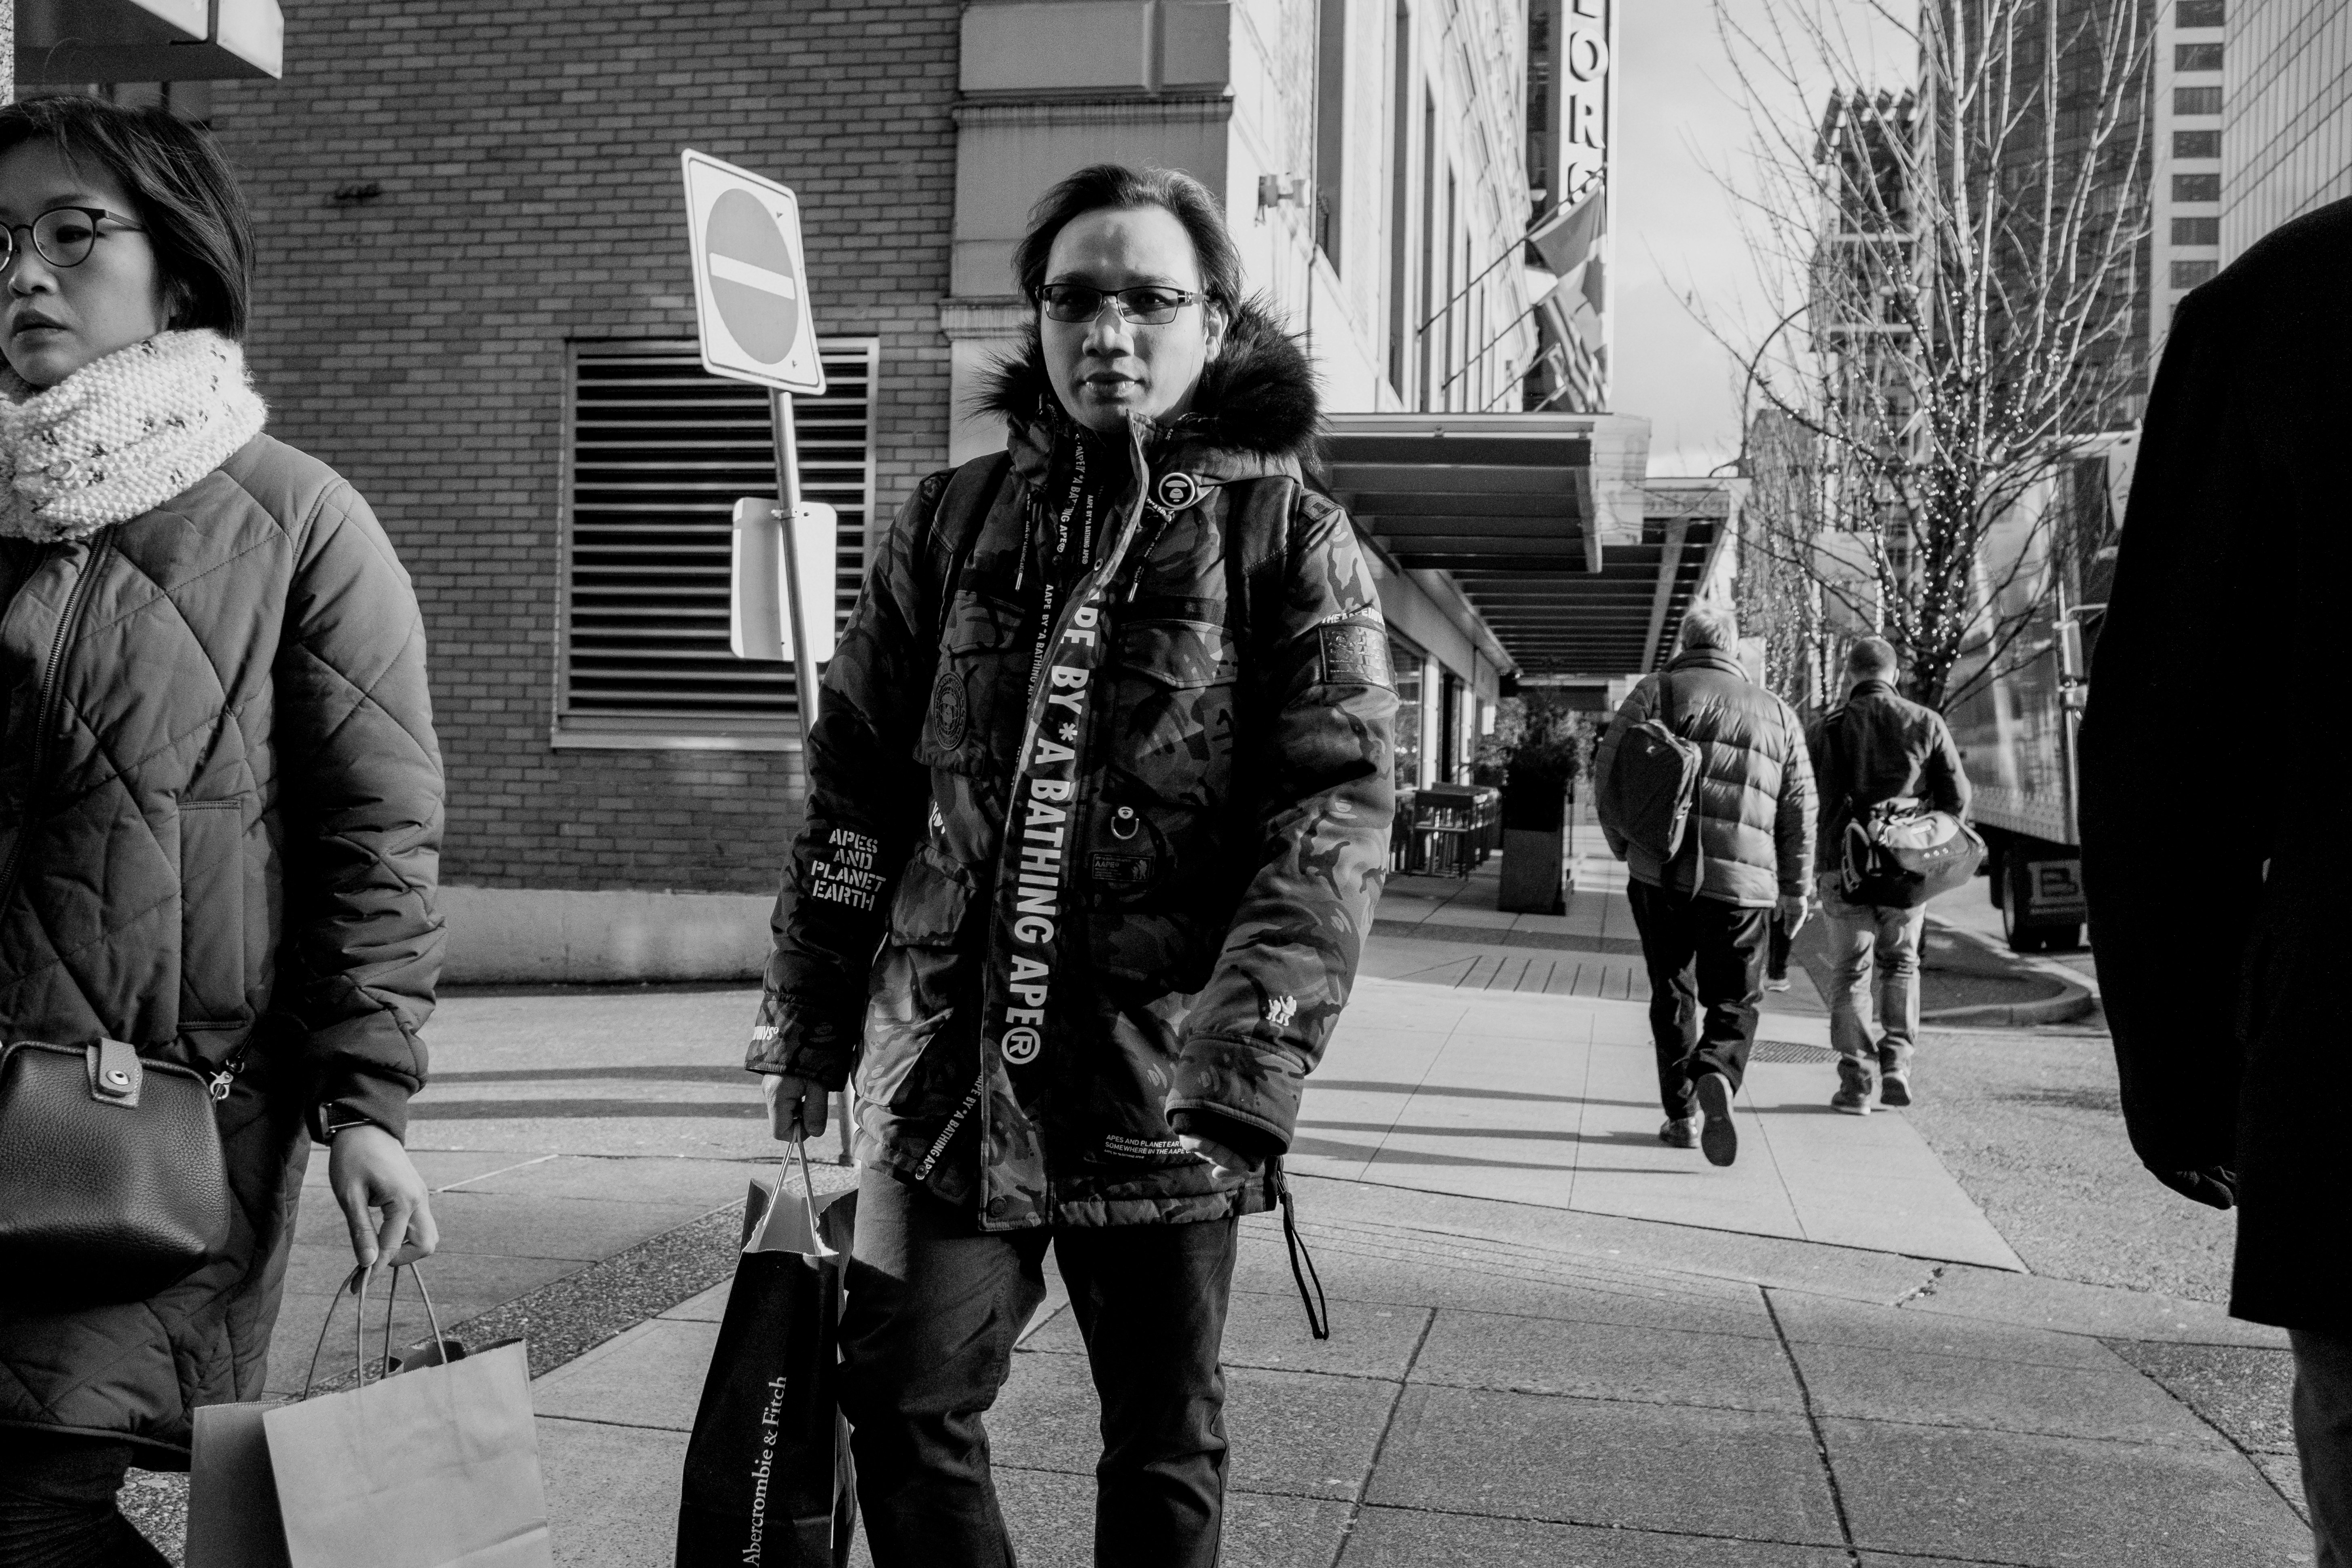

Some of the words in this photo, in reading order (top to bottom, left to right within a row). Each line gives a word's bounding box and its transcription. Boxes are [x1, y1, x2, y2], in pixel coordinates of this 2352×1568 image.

[1083, 525, 1091, 548] BATHING
[1043, 584, 1054, 610] AAPE
[1041, 614, 1049, 627] BY
[1048, 665, 1089, 715] BY
[828, 828, 878, 853] APES
[833, 848, 873, 870] AND
[1014, 779, 1070, 944] BATHING
[811, 860, 886, 892] PLANET
[812, 880, 875, 911] EARTH
[1001, 954, 1049, 1064] APE®
[970, 1072, 982, 1096] APE
[962, 1096, 977, 1109] BY
[930, 1119, 960, 1157] BATHING
[1105, 1141, 1148, 1155] SOMEWHERE
[1106, 1134, 1124, 1143] APES
[1124, 1138, 1140, 1146] AND
[1140, 1140, 1166, 1148] PLANET
[762, 1376, 787, 1427] Fitch
[764, 1430, 778, 1446] &
[743, 1449, 774, 1568] Abercrombie
